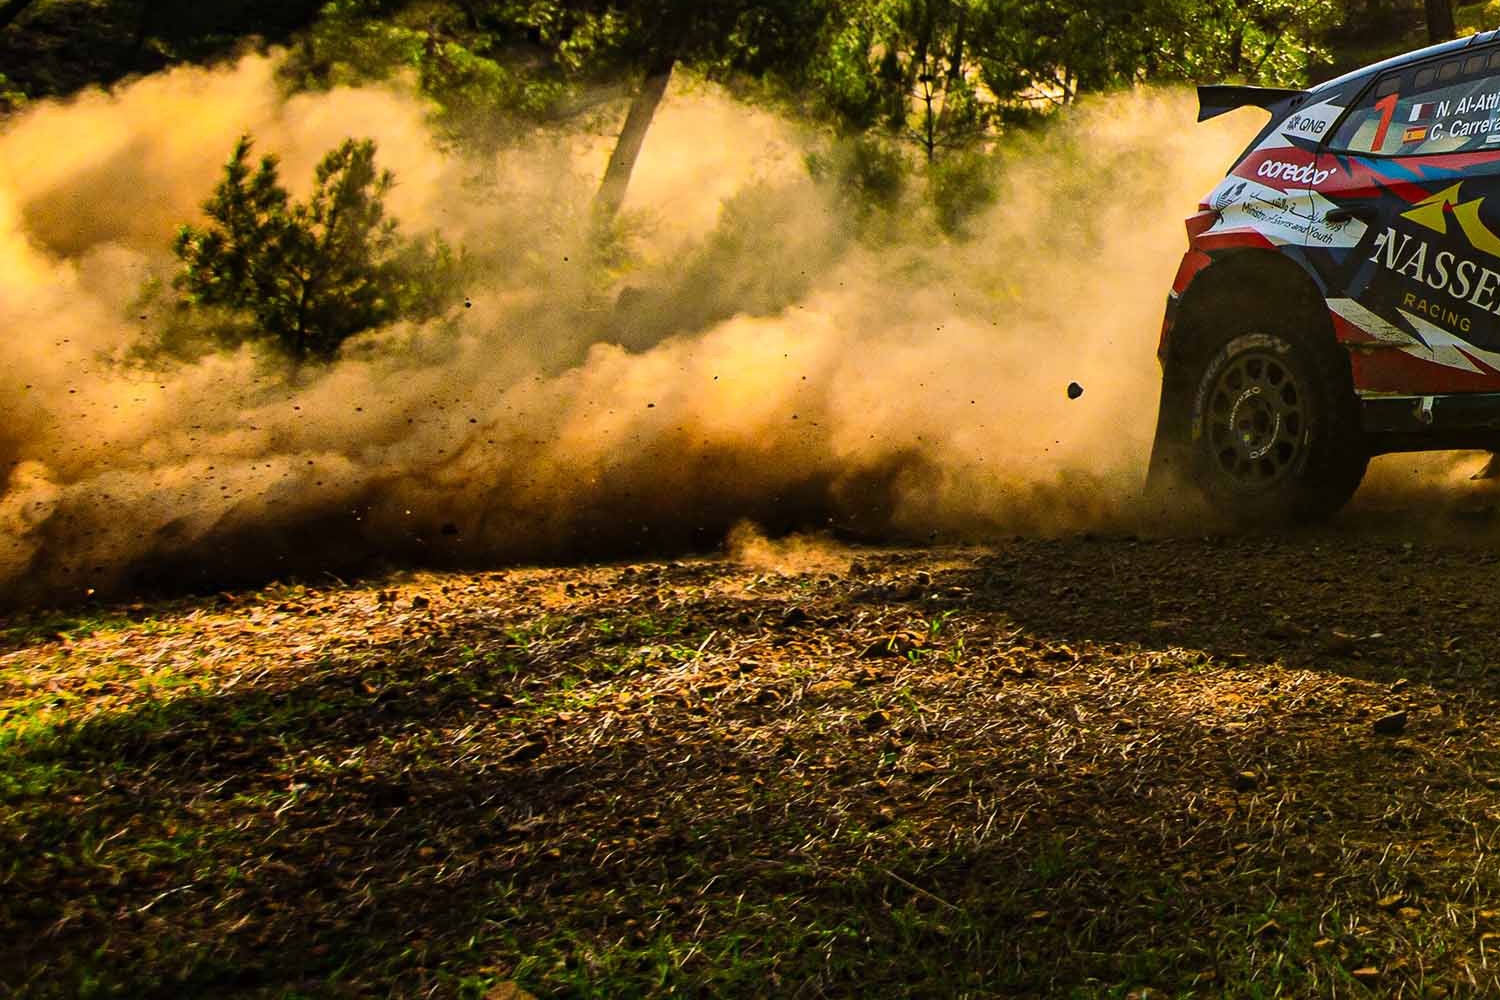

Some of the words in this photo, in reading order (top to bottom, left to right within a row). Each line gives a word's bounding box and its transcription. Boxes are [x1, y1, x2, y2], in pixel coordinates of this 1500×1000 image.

[1435, 101, 1450, 119] N.
[1299, 117, 1326, 134] QNB
[1370, 91, 1400, 152] 1
[1430, 123, 1443, 141] C.
[1257, 159, 1330, 185] ooredoo
[1308, 226, 1333, 244] Youth
[1403, 292, 1472, 332] RACING
